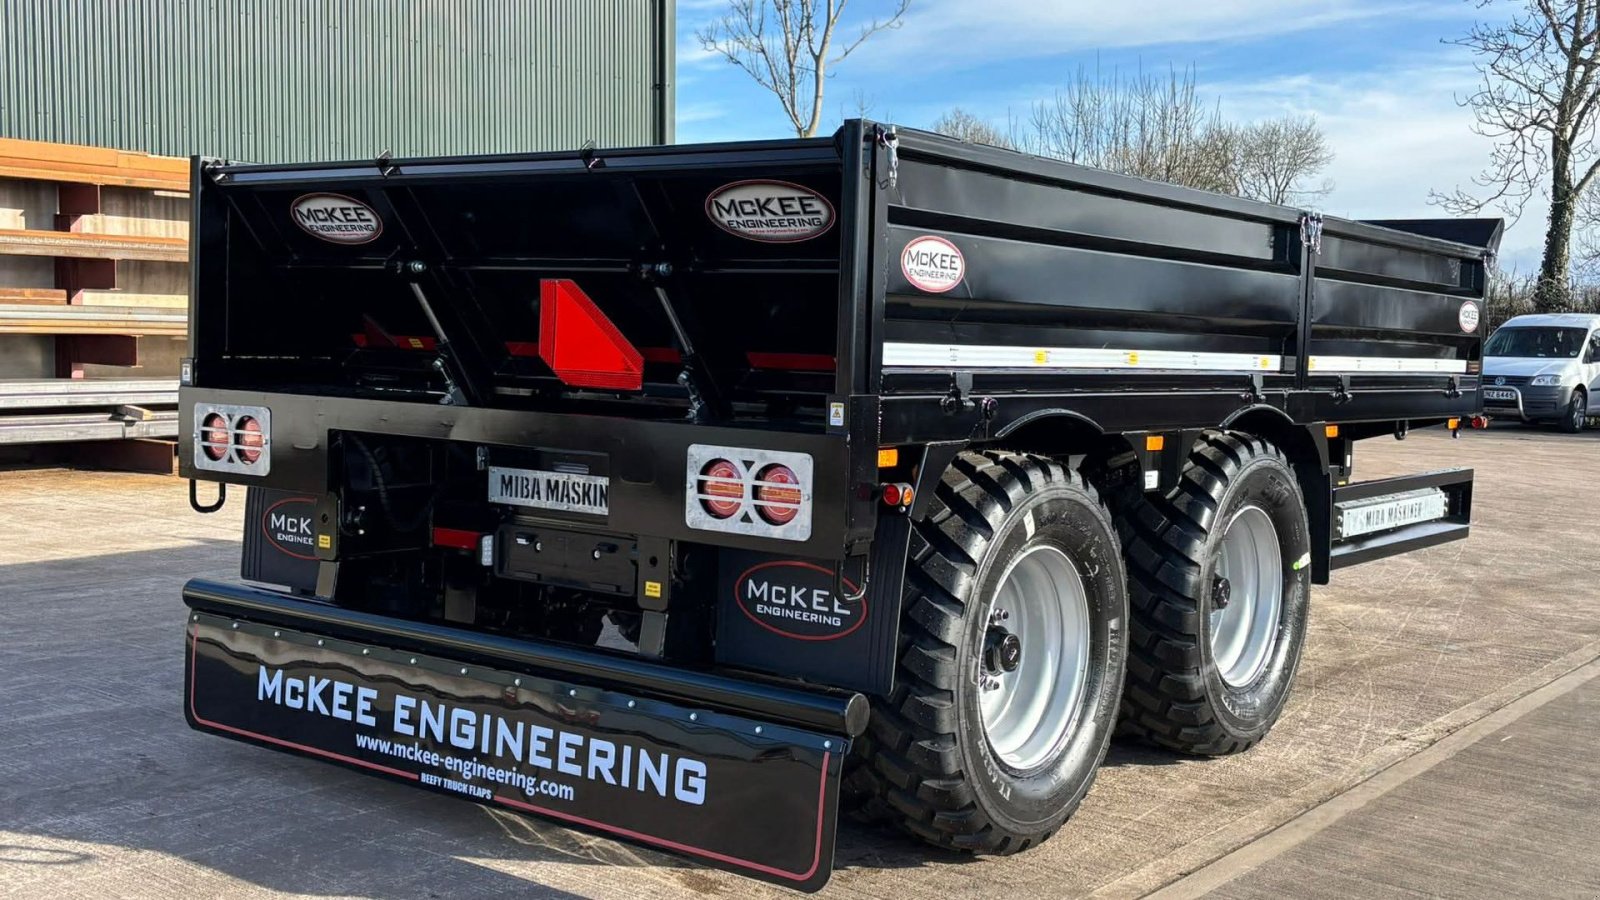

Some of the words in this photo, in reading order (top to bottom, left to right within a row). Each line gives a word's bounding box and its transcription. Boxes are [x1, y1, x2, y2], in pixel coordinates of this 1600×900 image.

[309, 224, 375, 232] ENGINEERING
[727, 217, 822, 229] ENGINEERING
[909, 268, 957, 281] ENGINEERING
[500, 474, 542, 501] MIBA
[546, 478, 609, 508] MASKIN
[271, 512, 312, 535] McK
[277, 532, 315, 546] ENGINEE
[756, 604, 841, 627] ENGINEERING
[393, 694, 708, 806] ENGINEERING
[355, 733, 575, 802] www.mckee-engineering.com
[421, 773, 442, 786] BEEFY
[443, 778, 468, 793] TRUCK
[469, 784, 492, 800] FLAPS
